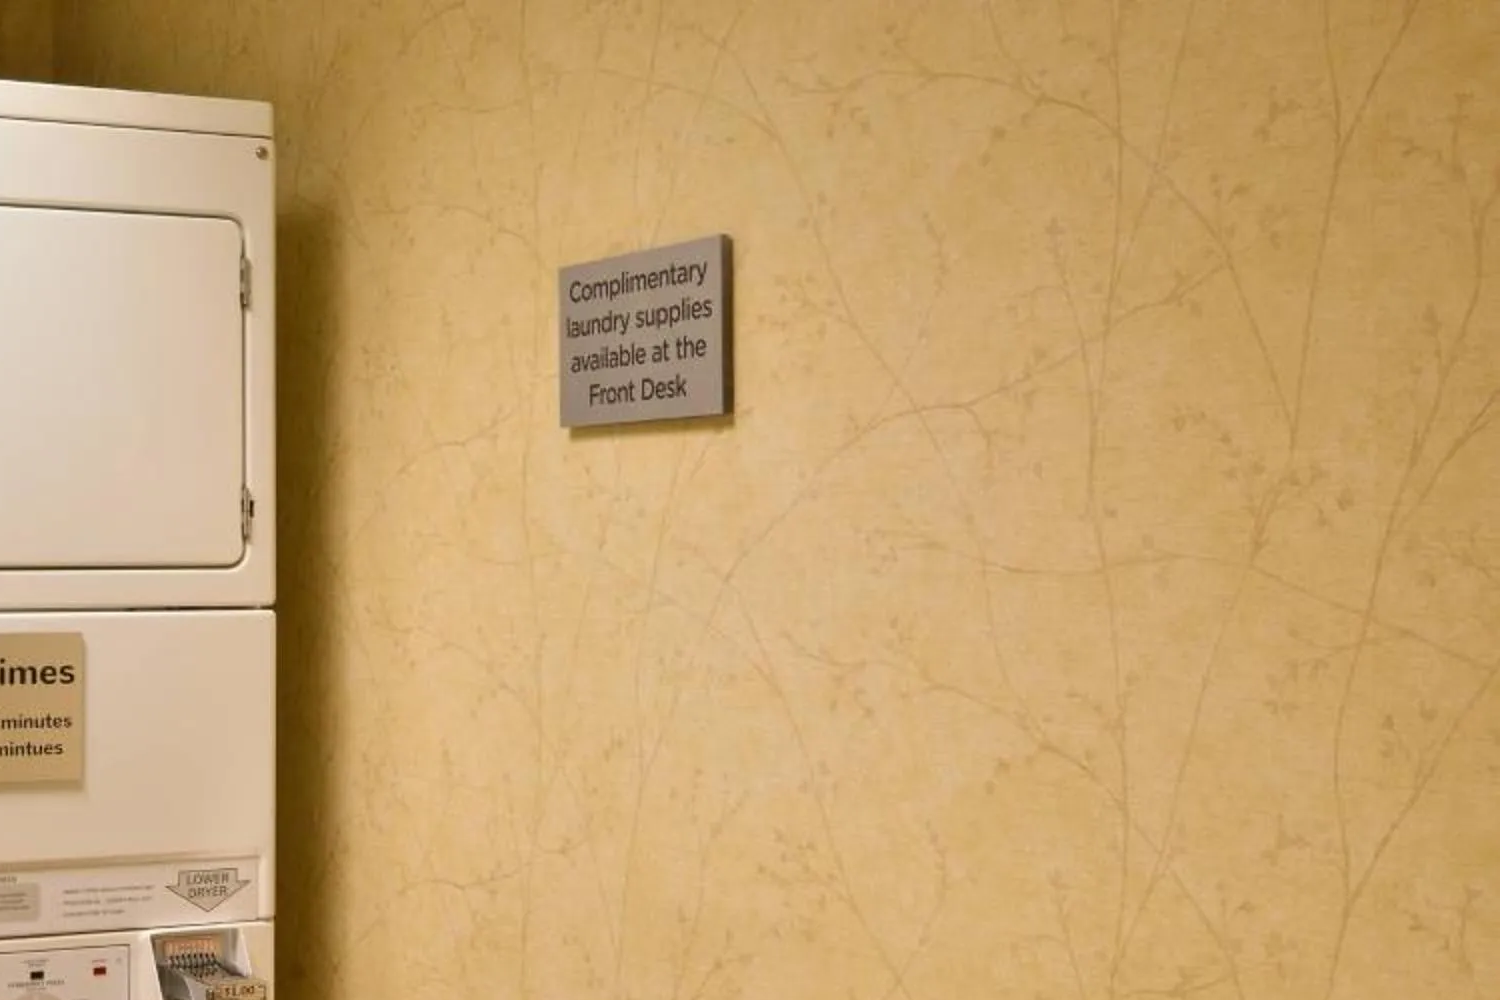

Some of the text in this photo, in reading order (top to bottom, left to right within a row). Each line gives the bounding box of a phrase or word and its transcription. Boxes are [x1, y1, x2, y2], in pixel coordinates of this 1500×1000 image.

[569, 261, 708, 304] Complimentary
[566, 297, 713, 338] laundry supplies
[570, 336, 707, 373] available at the
[589, 374, 687, 407] Front Desk
[1, 713, 73, 729] minutes
[186, 872, 229, 885] LOWER
[188, 886, 227, 898] DRYER
